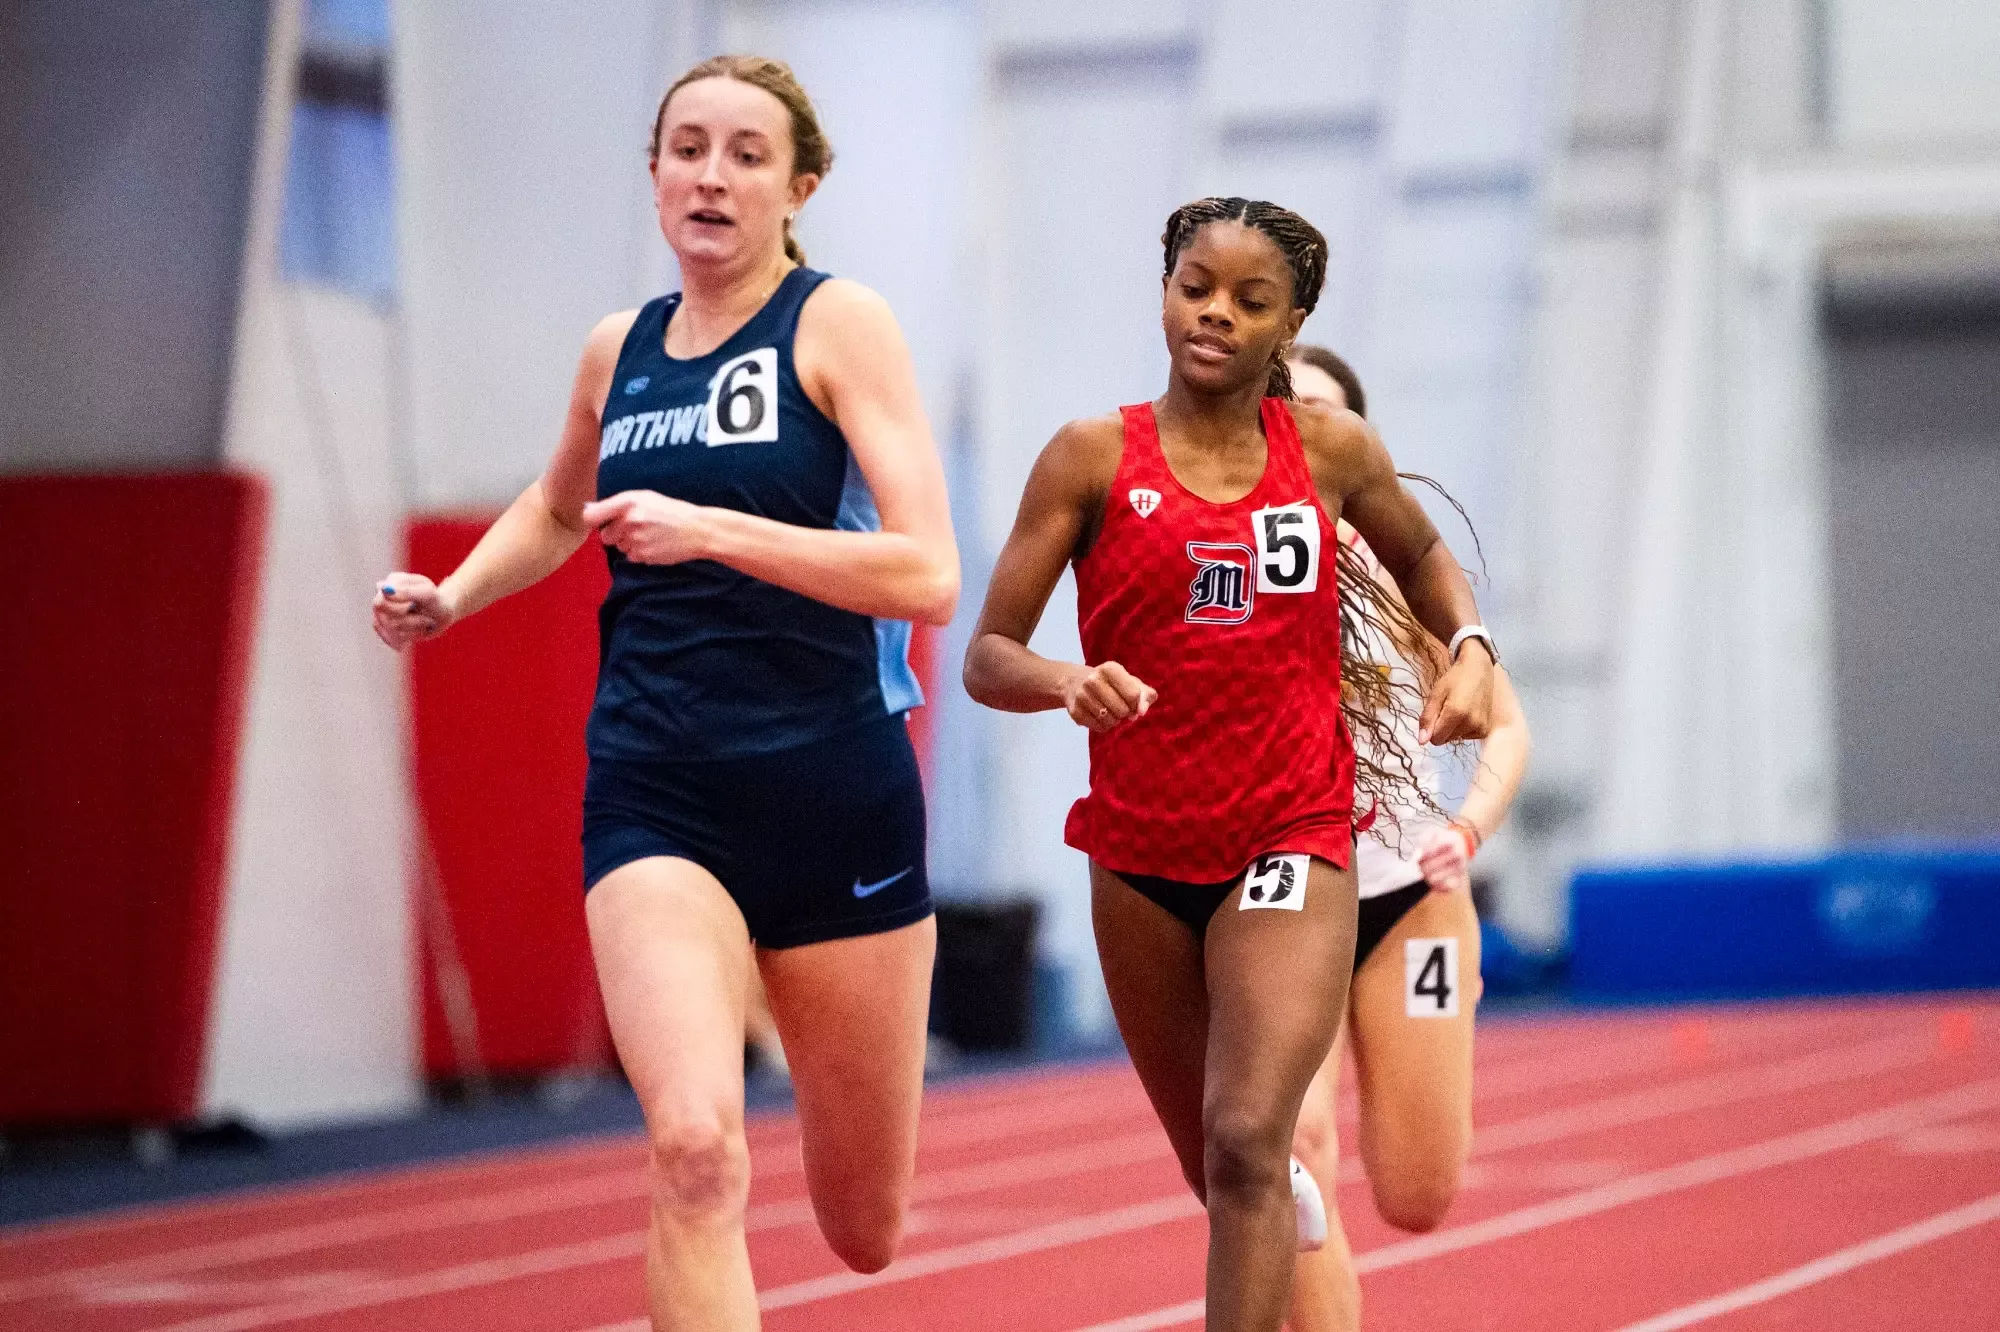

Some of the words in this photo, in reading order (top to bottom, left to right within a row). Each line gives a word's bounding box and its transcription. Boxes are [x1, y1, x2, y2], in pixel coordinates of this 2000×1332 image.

[717, 360, 766, 435] 6
[600, 403, 709, 460] ORTHWO
[1264, 512, 1310, 587] 5
[1249, 855, 1295, 903] 5
[1414, 946, 1452, 1010] 4
